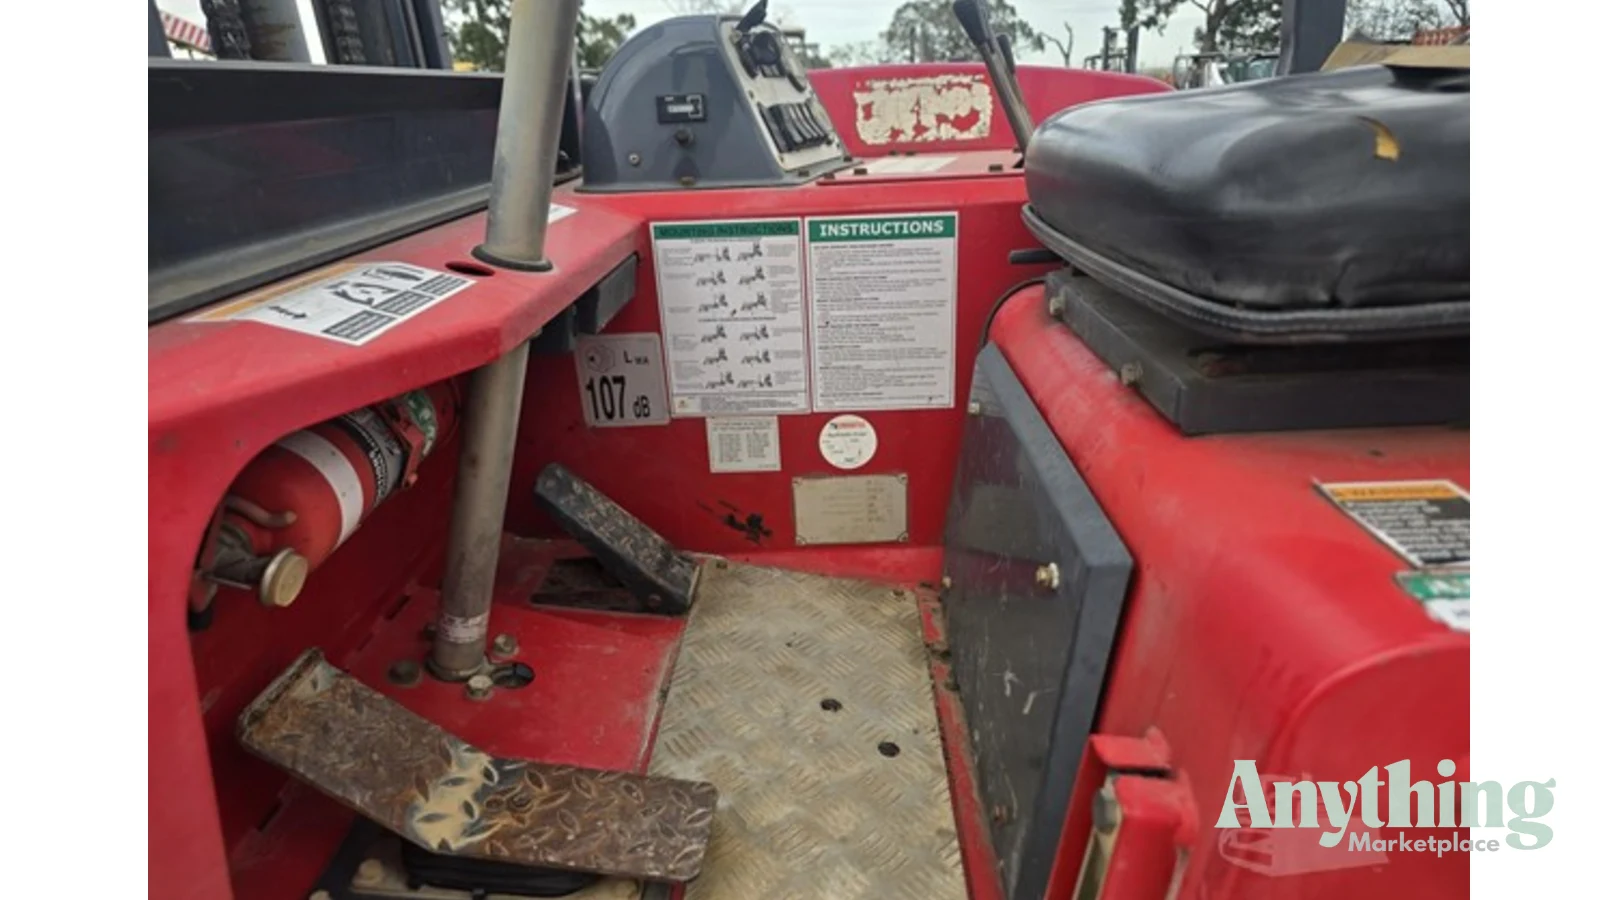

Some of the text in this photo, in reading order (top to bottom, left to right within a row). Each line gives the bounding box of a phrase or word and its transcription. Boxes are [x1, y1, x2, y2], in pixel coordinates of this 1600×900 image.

[717, 222, 795, 236] INSTRUCTIONS
[819, 219, 945, 237] INSTRUCTIONS
[623, 350, 633, 364] L
[586, 374, 651, 420] 107 dB
